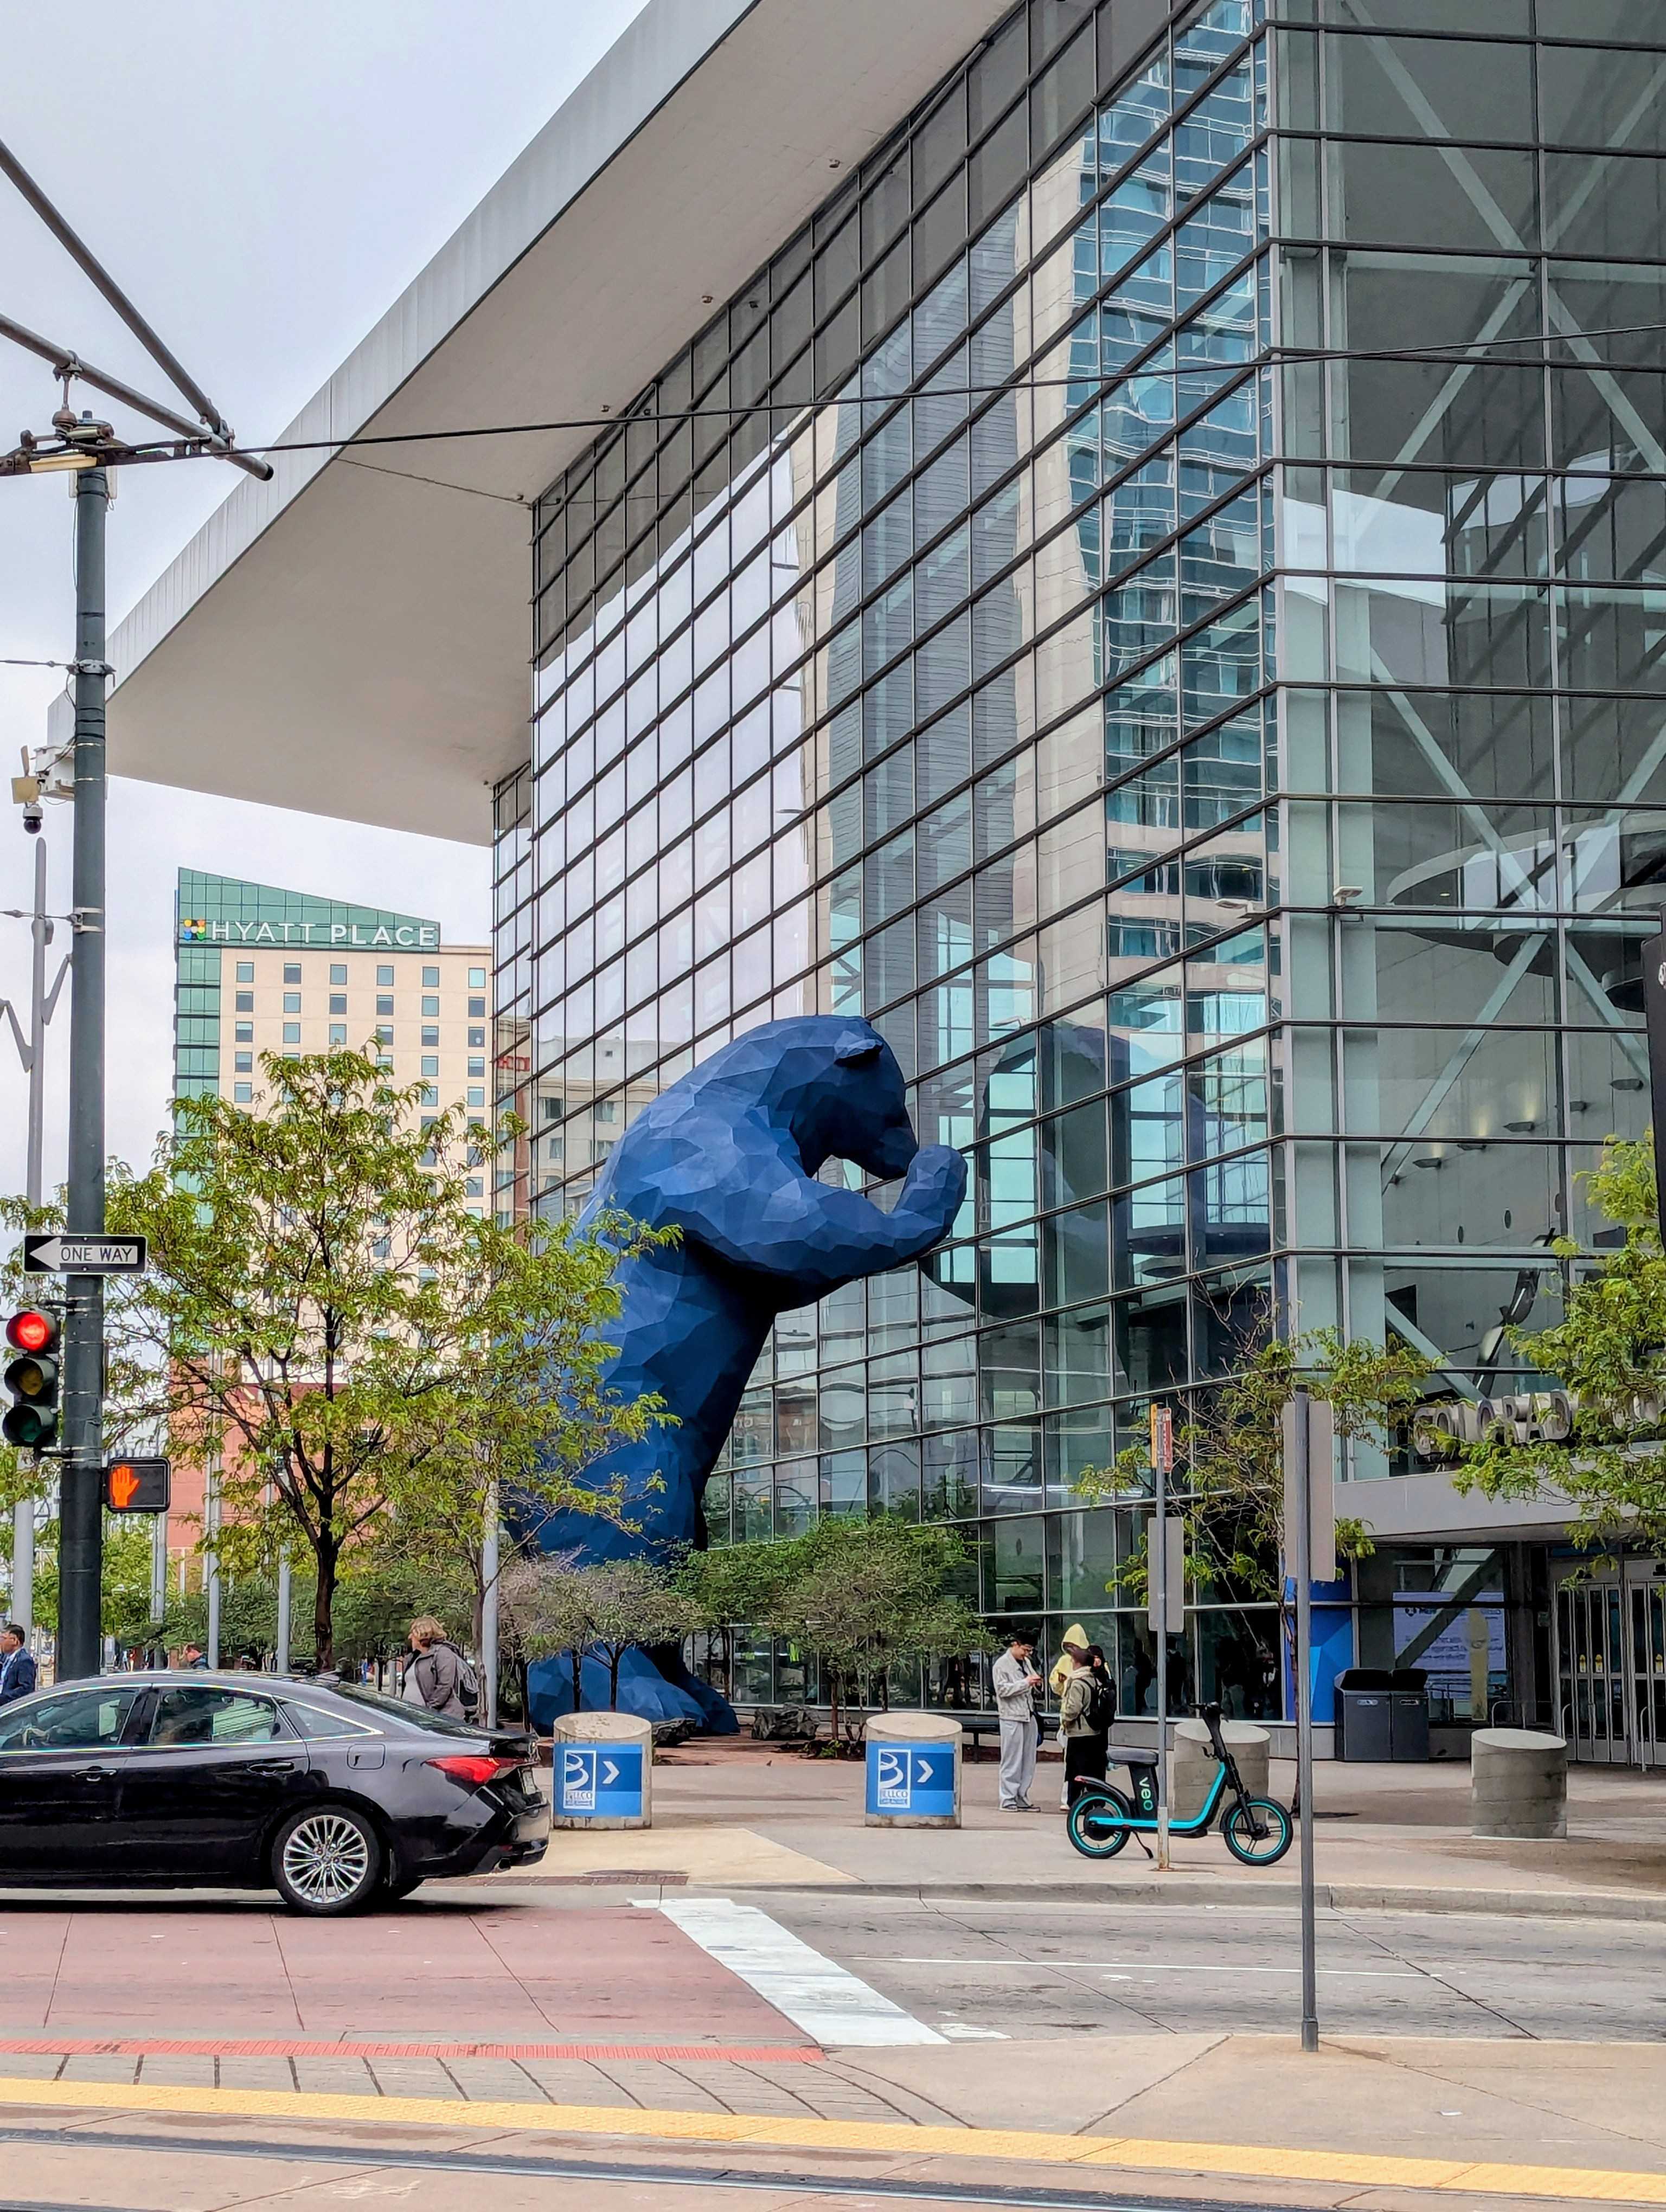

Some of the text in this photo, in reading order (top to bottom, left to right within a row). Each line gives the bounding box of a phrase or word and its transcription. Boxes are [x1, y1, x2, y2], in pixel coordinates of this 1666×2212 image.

[212, 919, 437, 947] HYATT PLACE
[60, 1246, 133, 1262] ONE WAY
[1412, 1390, 1598, 1456] COLORAD
[1139, 1776, 1154, 1811] veo
